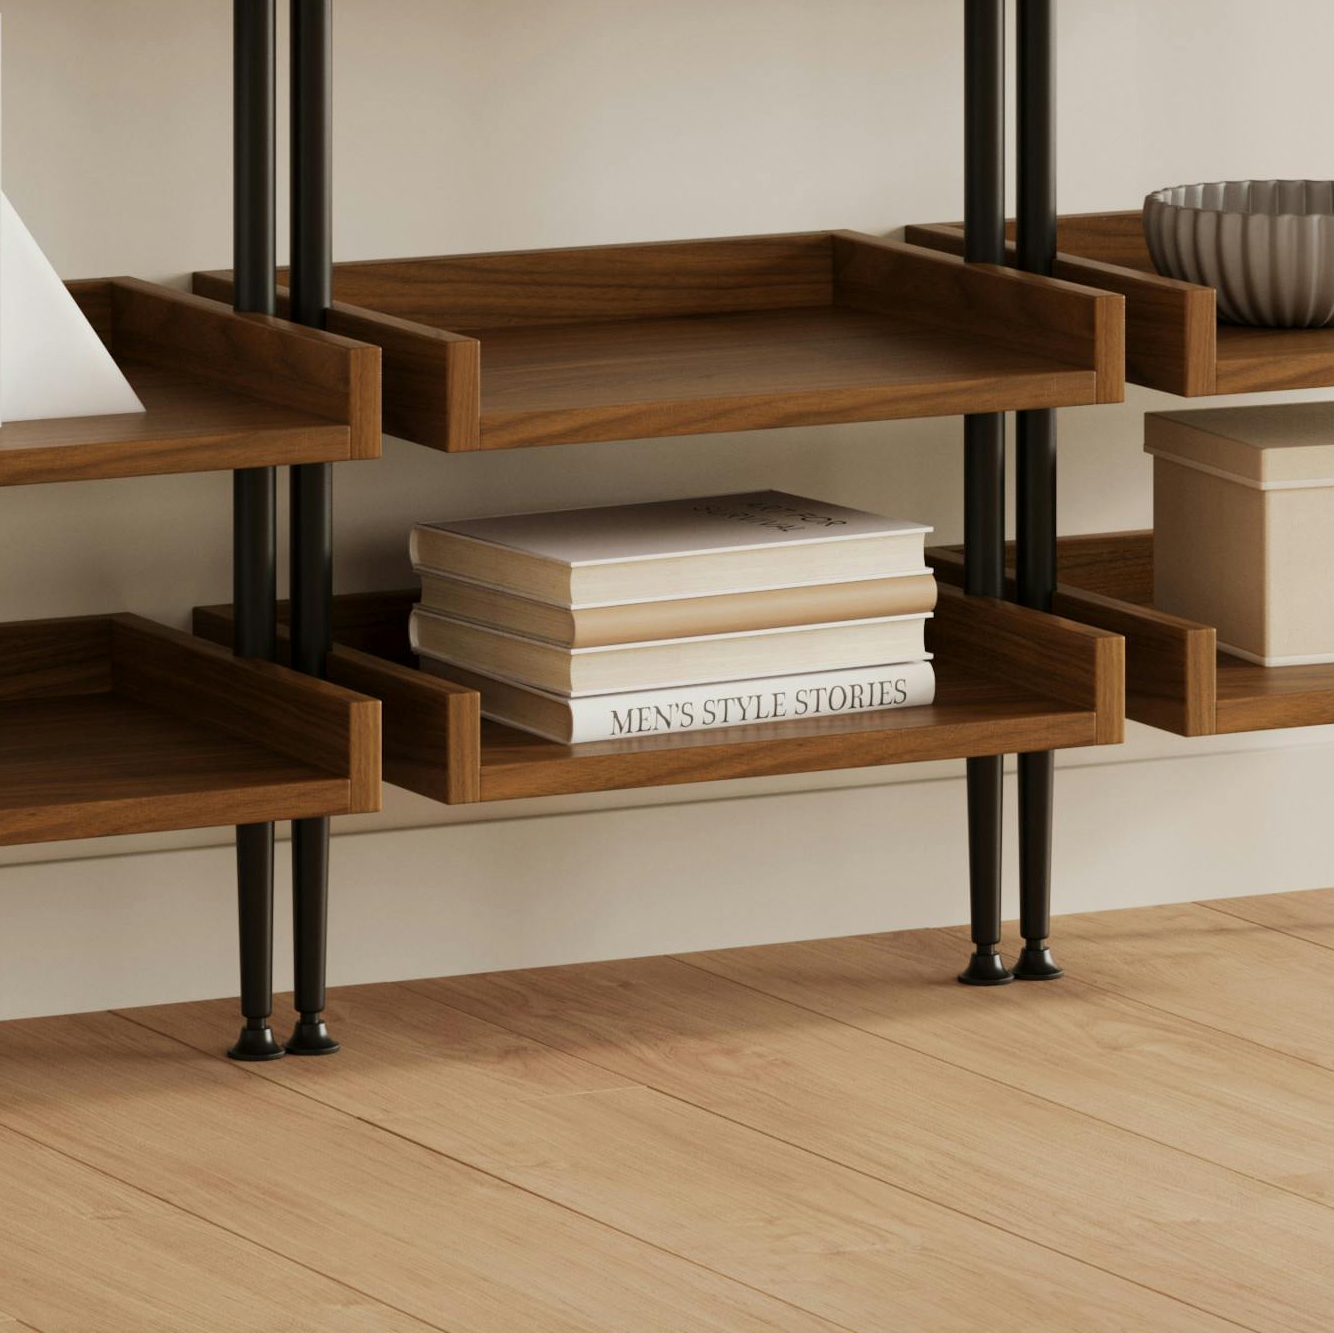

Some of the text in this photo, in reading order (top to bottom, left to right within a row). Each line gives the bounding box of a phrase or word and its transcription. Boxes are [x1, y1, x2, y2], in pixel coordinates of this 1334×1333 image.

[609, 678, 909, 736] MEN'S STYLE STORIES
